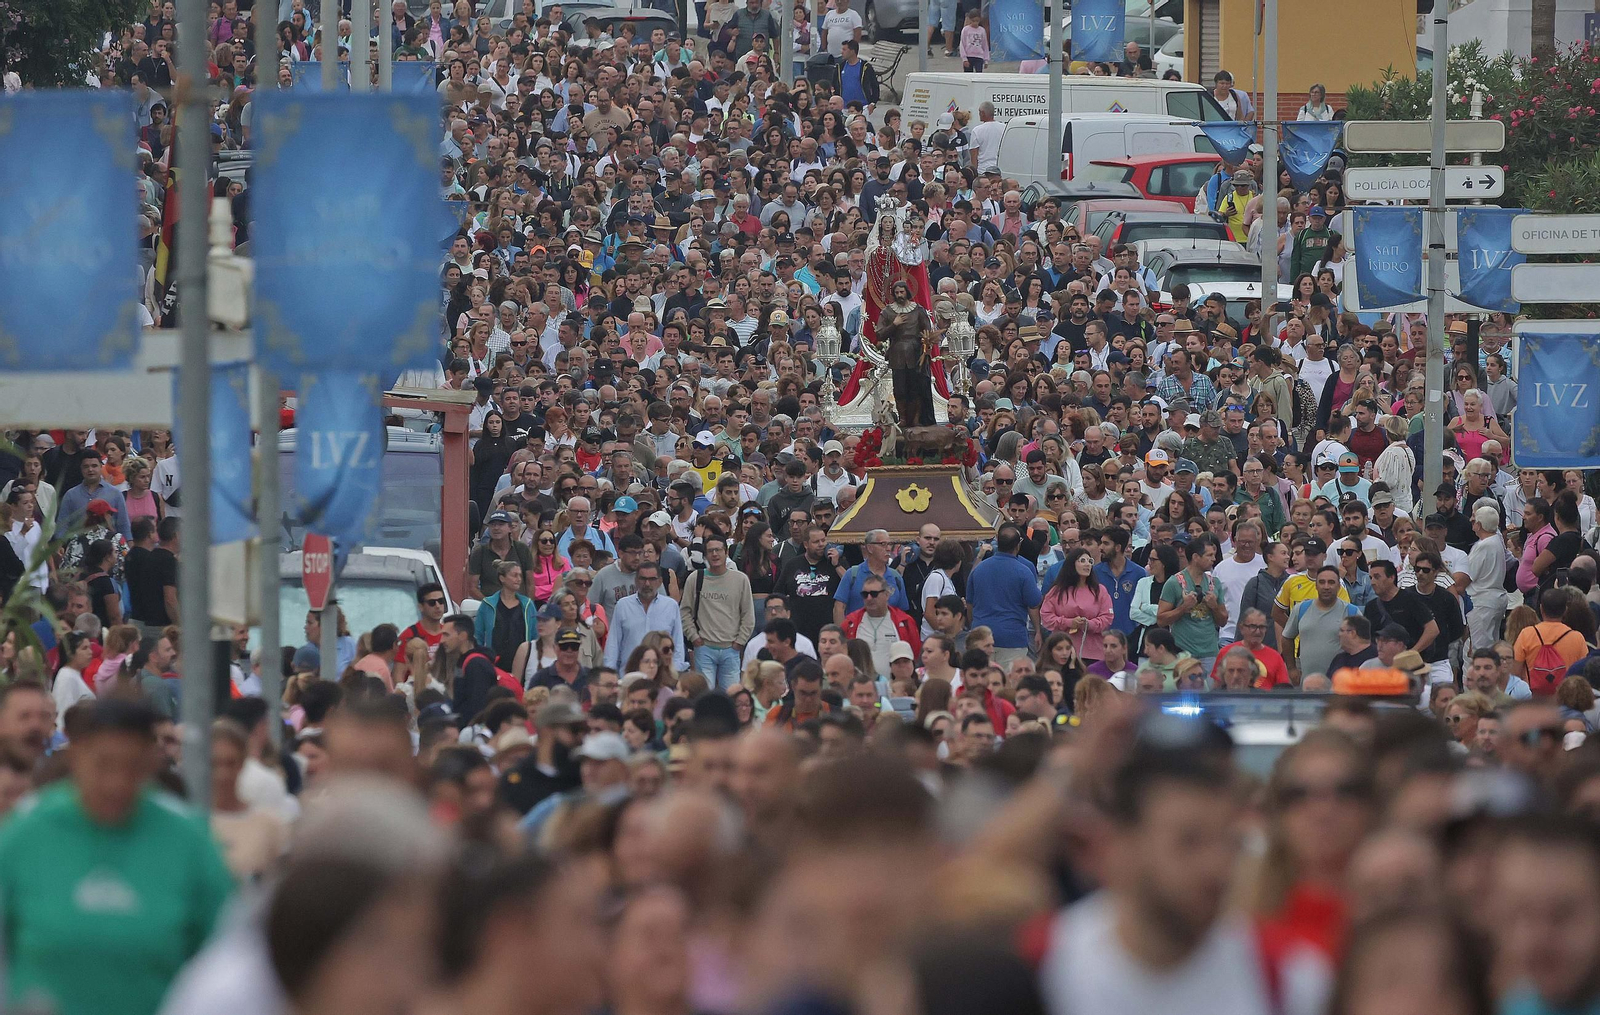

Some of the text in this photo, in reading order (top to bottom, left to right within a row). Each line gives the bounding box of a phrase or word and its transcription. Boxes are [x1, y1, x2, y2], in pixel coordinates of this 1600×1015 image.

[1081, 15, 1117, 32] LVZ
[992, 93, 1047, 104] ESPECIALISTAS
[1004, 107, 1049, 117] REVESTIMIE
[1354, 179, 1432, 191] POLICÍA LOCA
[1522, 229, 1569, 240] OFICINA
[1572, 229, 1588, 239] DE
[1375, 245, 1399, 256] SAN
[1470, 248, 1515, 271] LVZ
[1369, 260, 1409, 274] ISIDRO
[1532, 382, 1589, 408] LVZ
[310, 430, 377, 469] LVZ
[304, 552, 329, 574] STOP
